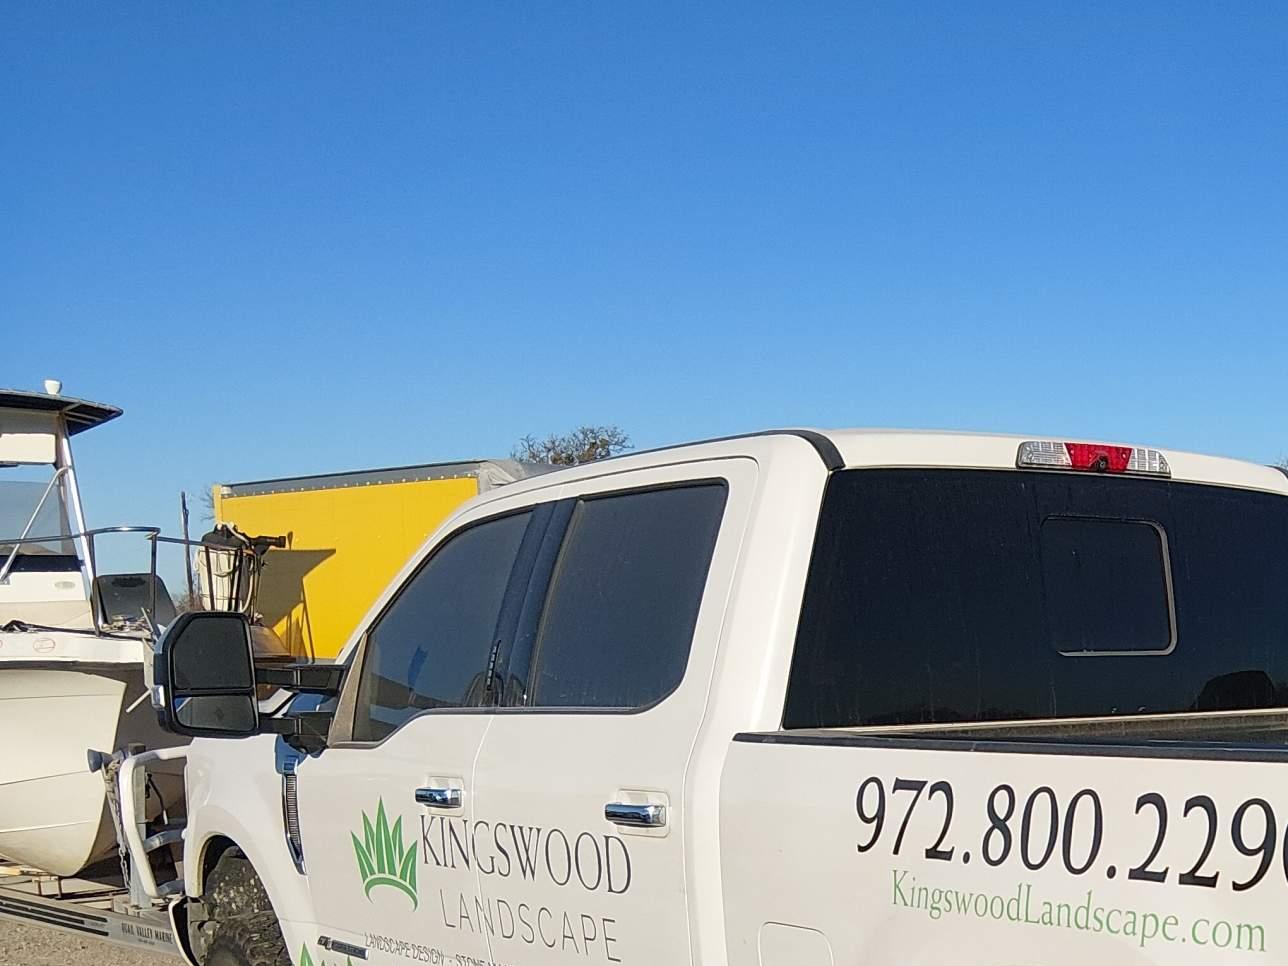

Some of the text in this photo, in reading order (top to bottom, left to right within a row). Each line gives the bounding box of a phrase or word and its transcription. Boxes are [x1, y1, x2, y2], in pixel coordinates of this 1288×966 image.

[420, 814, 633, 895] KINGSWOOD
[136, 926, 153, 940] VALLEY
[439, 888, 623, 963] LANDSCAPE
[891, 868, 1267, 953] KingswoodLandscape.com
[364, 931, 411, 958] LANDSCAPE
[411, 943, 445, 966] DESIGN
